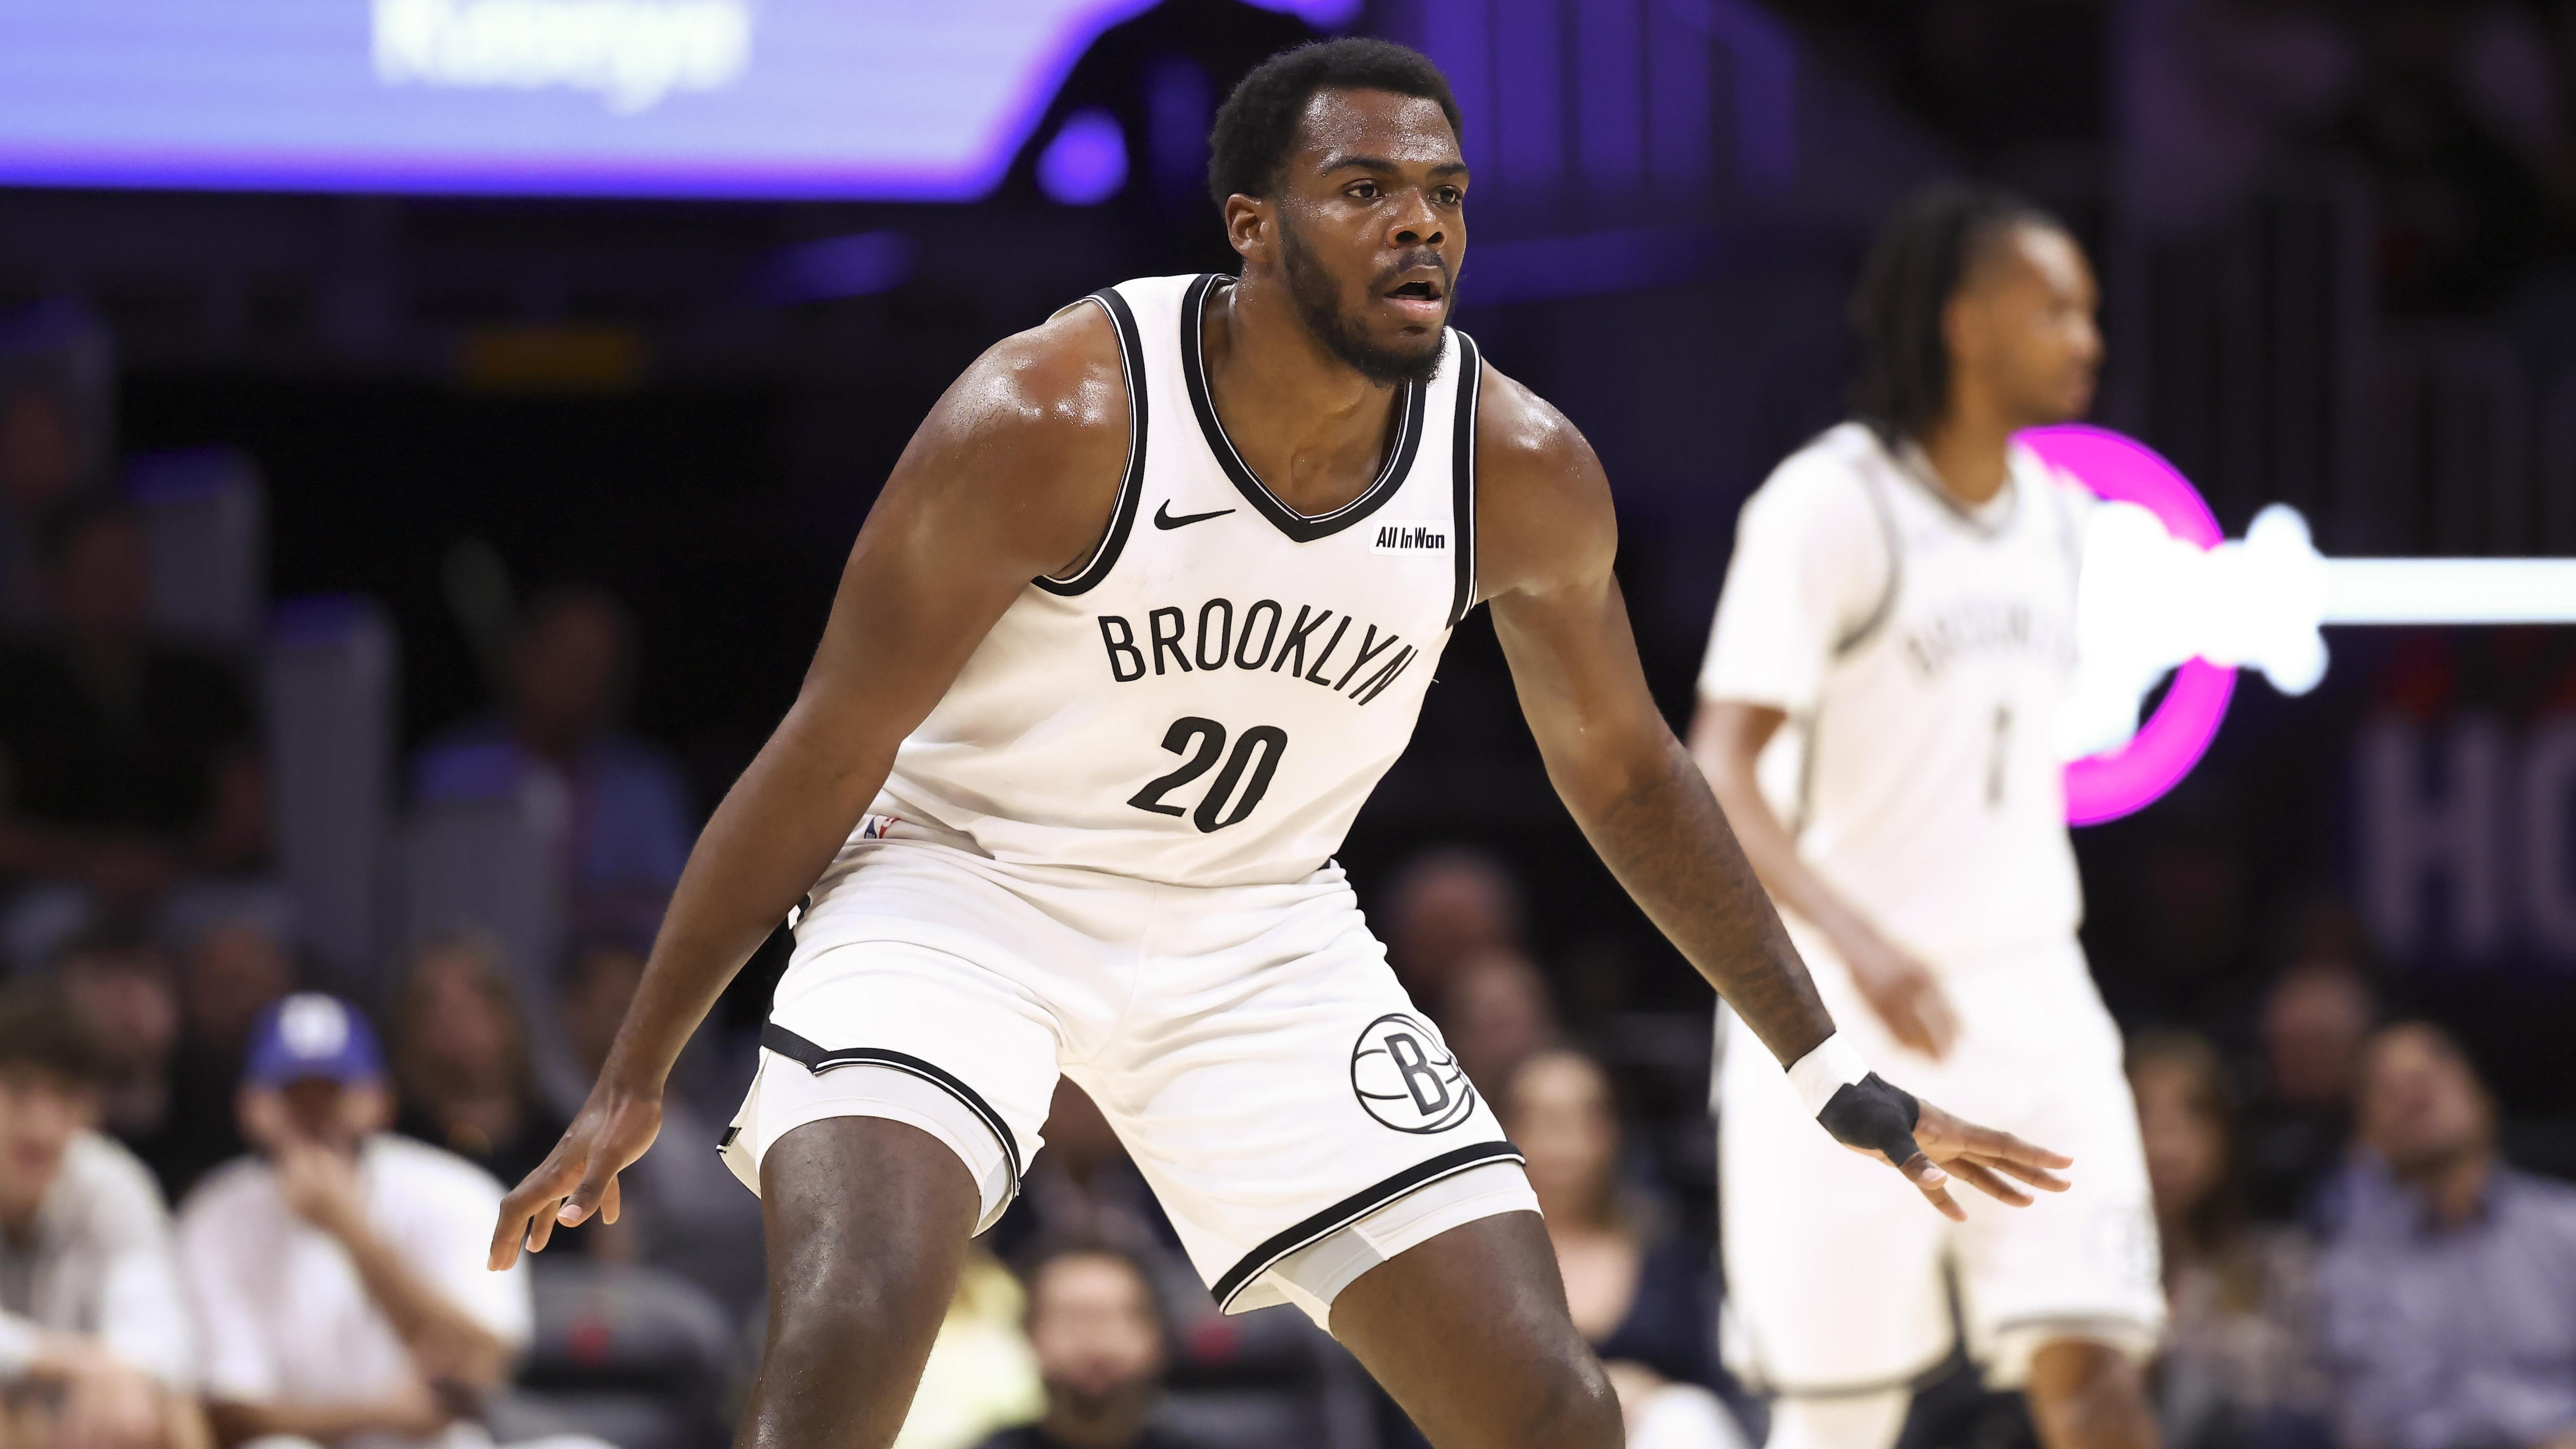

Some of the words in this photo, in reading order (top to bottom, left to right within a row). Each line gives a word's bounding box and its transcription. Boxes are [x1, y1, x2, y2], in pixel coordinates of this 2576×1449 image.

[1376, 526, 1398, 548] All
[1400, 527, 1413, 549] In
[1415, 527, 1445, 549] Won
[1097, 598, 1418, 706] BROOKLYN
[1127, 716, 1288, 833] 20
[1384, 1033, 1449, 1116] B
